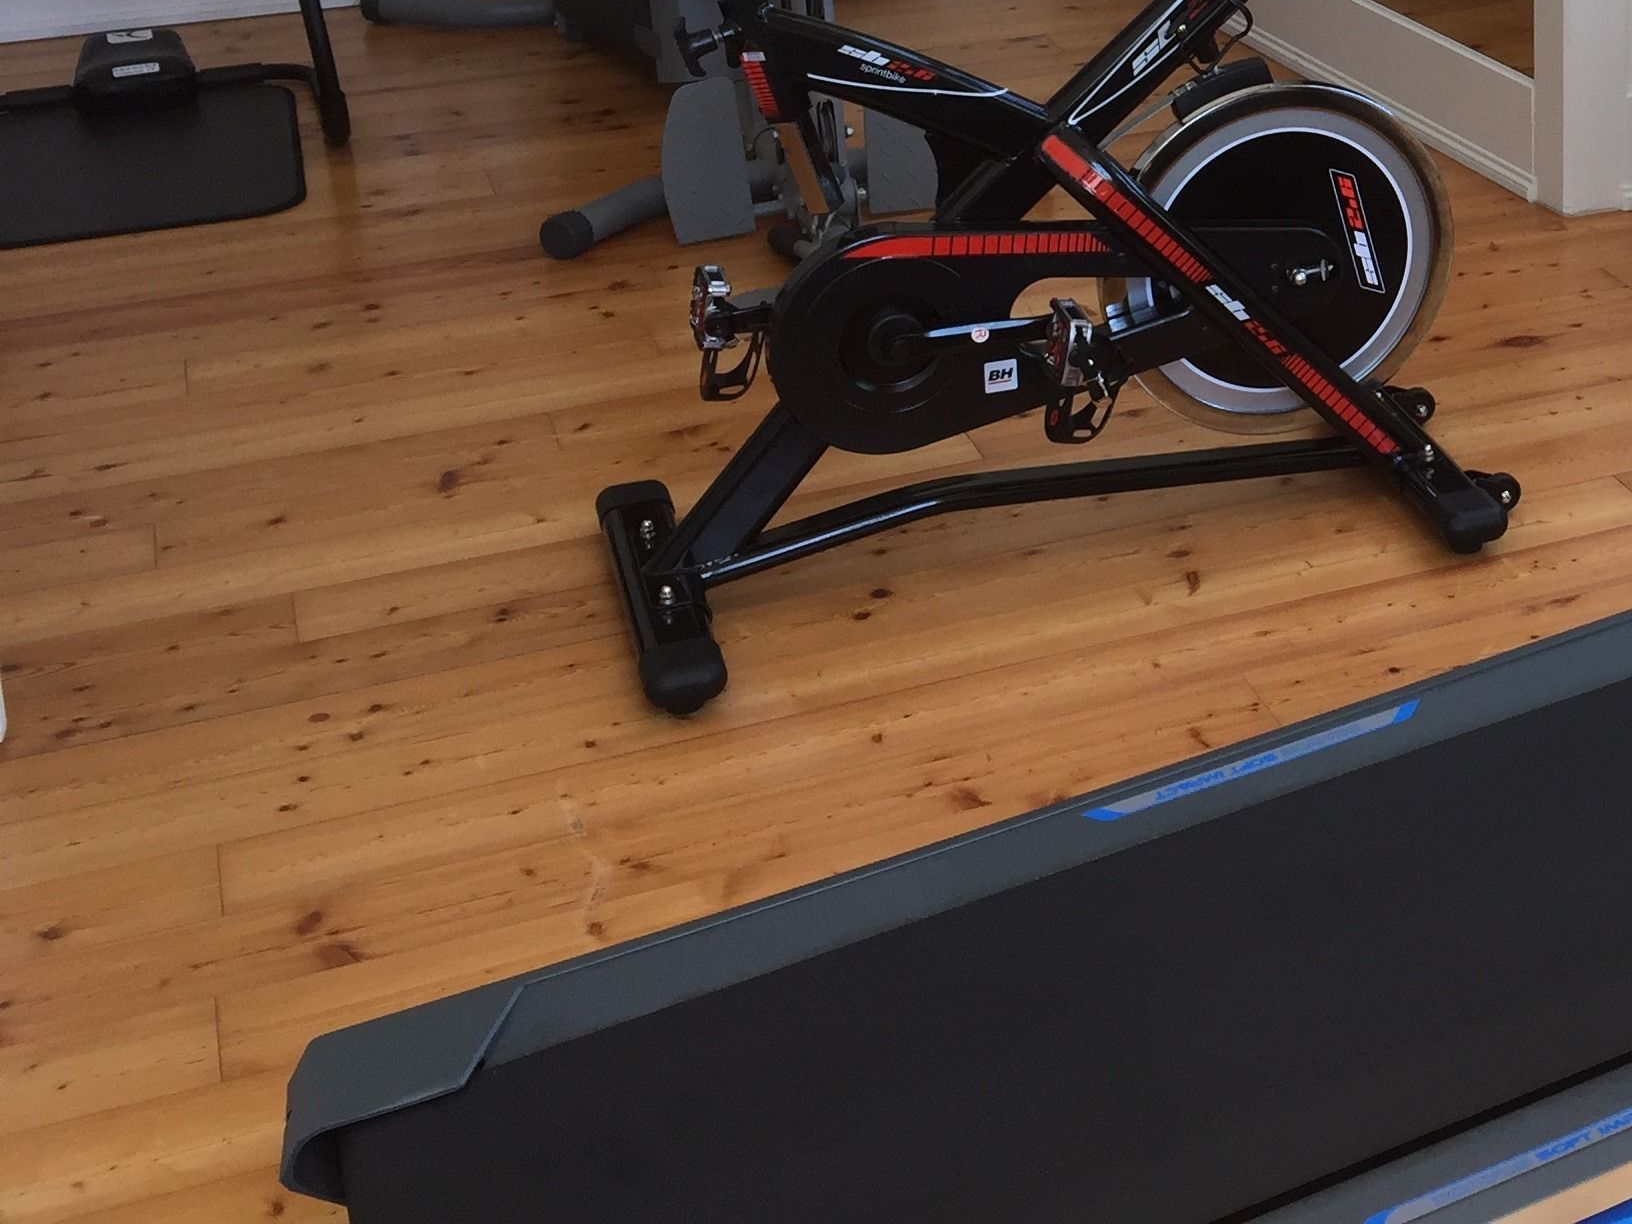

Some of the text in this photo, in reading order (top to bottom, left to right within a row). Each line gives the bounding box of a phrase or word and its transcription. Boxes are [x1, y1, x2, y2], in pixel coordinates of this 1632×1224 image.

[860, 63, 907, 83] sprintbike
[988, 367, 1013, 381] BH
[1535, 1131, 1592, 1161] SOFT
